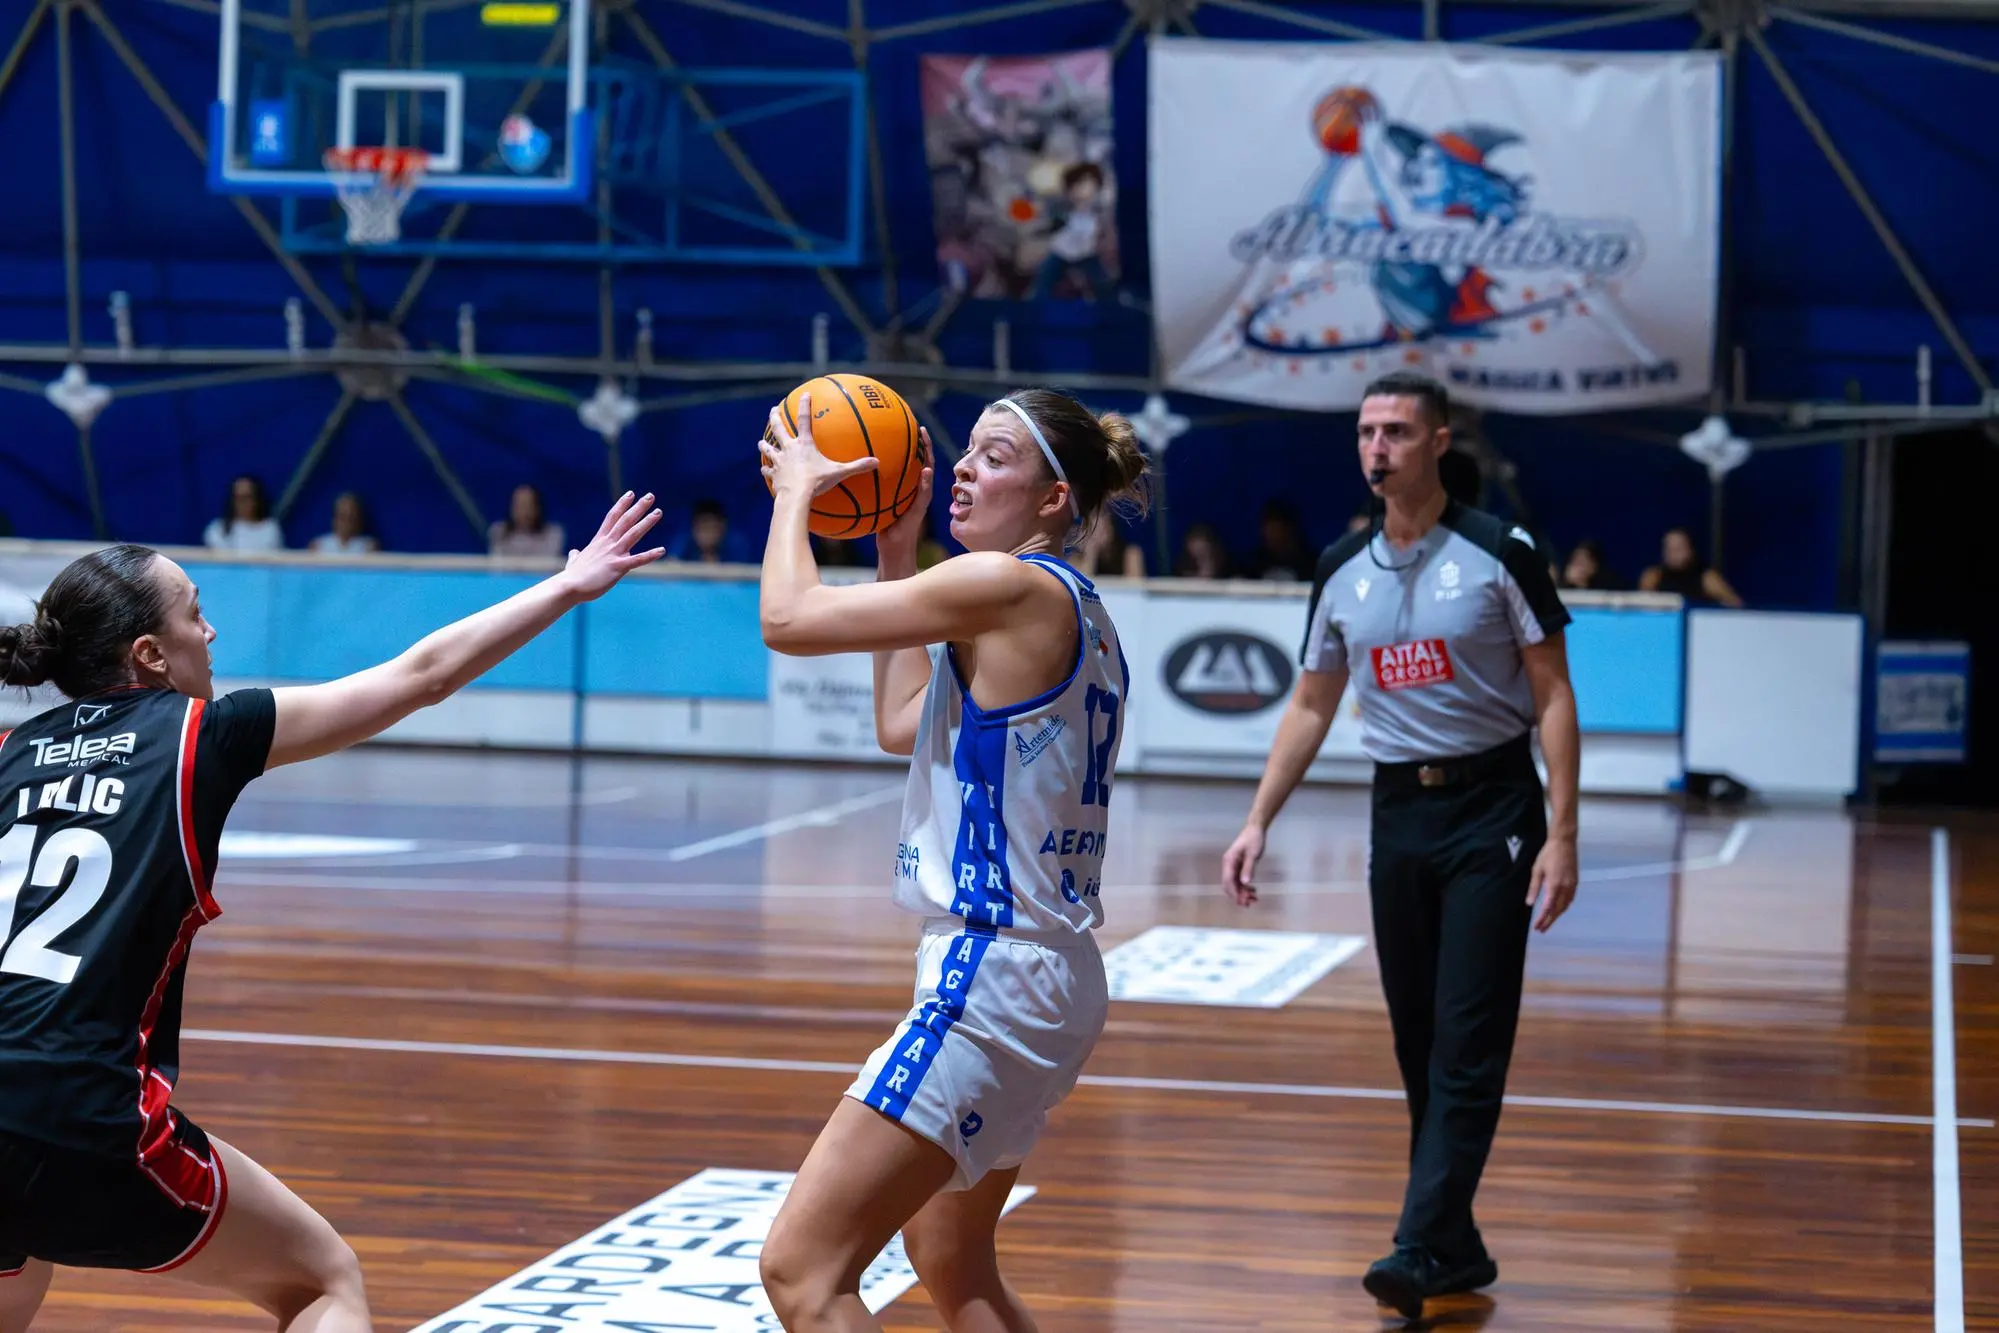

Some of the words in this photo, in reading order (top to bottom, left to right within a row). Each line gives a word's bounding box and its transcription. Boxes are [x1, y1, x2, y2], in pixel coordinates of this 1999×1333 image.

[859, 385, 885, 409] FIBA
[1381, 640, 1442, 669] ATTAL
[1381, 660, 1446, 684] GROUP
[29, 732, 137, 767] Telea
[1015, 714, 1061, 759] Artemide
[0, 823, 113, 984] 12
